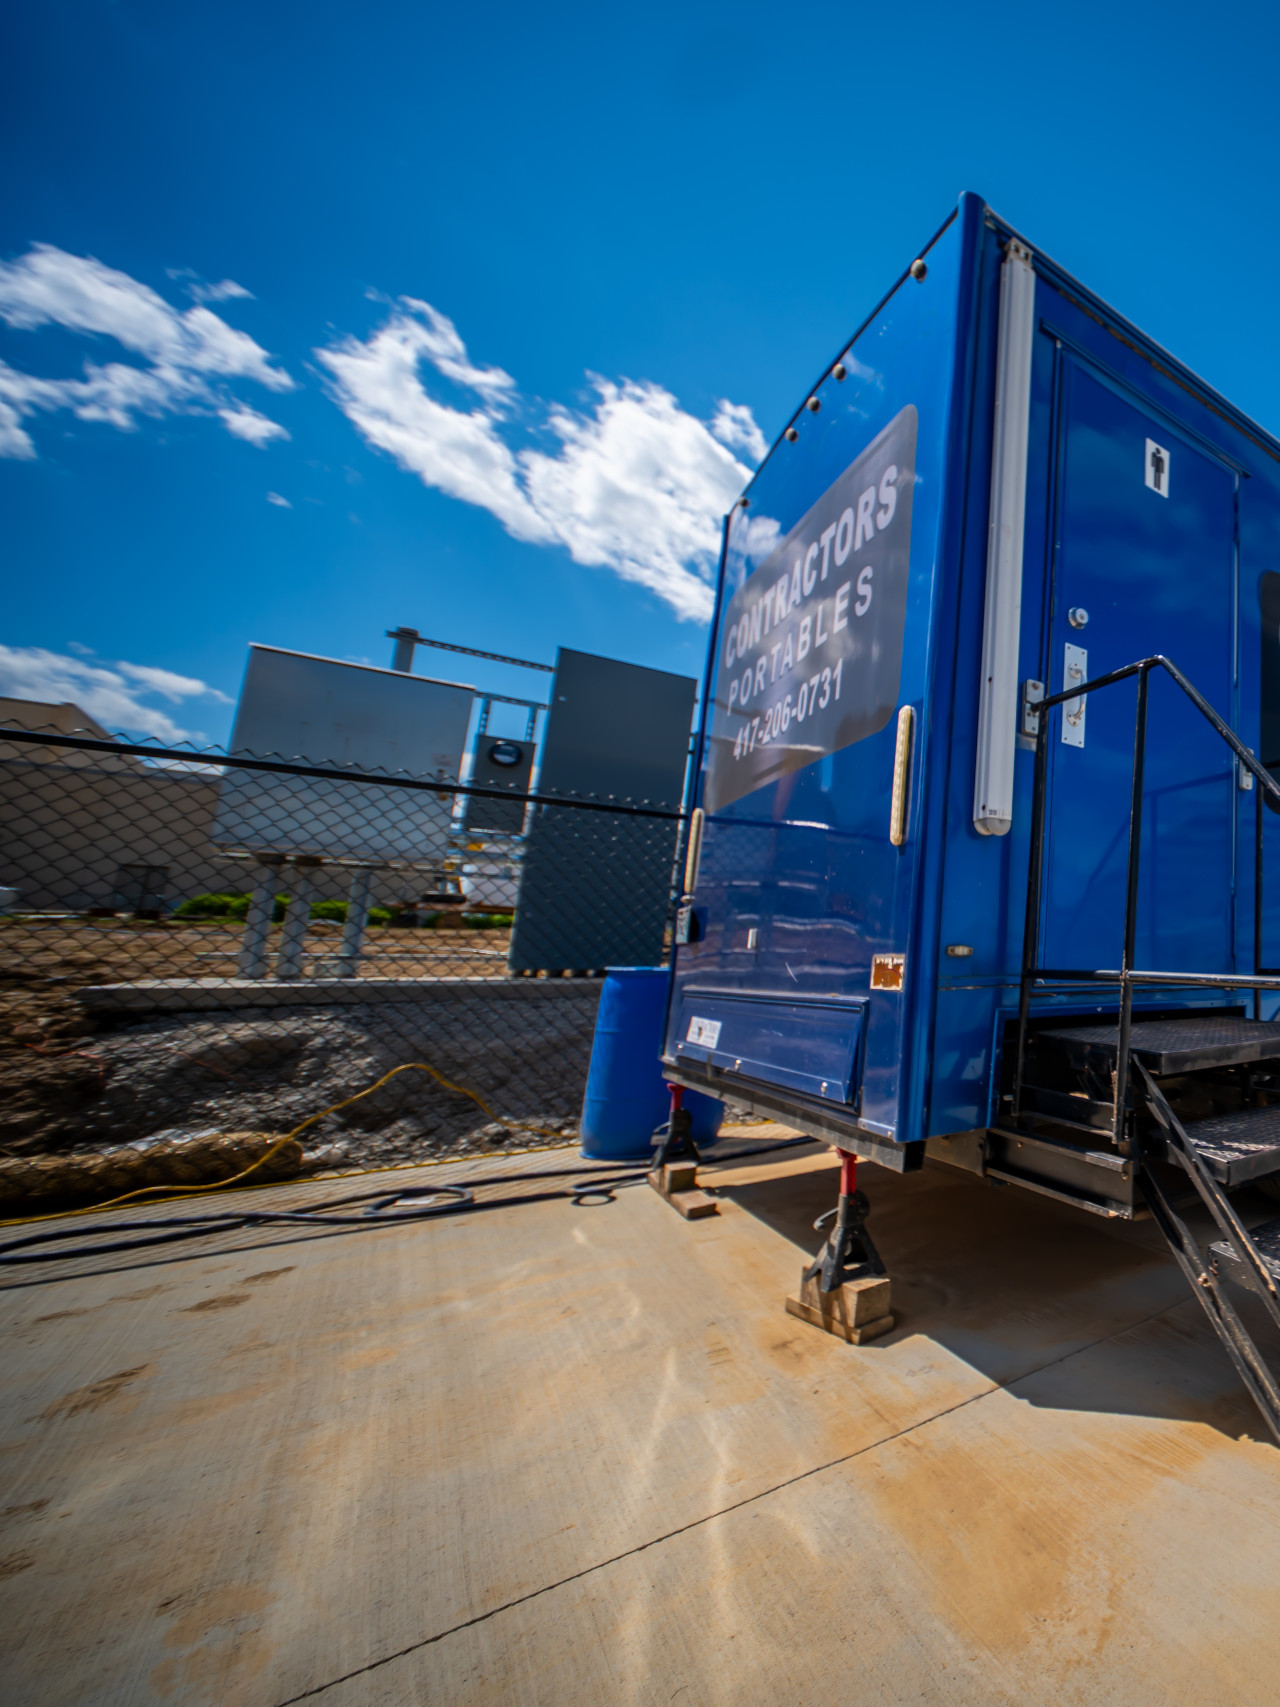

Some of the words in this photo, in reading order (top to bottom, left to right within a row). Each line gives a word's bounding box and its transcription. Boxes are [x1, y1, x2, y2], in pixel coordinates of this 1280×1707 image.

[726, 464, 898, 669] CONTRACTORS
[727, 566, 873, 717] PORTABLES
[732, 658, 844, 762] 417-206-0731
